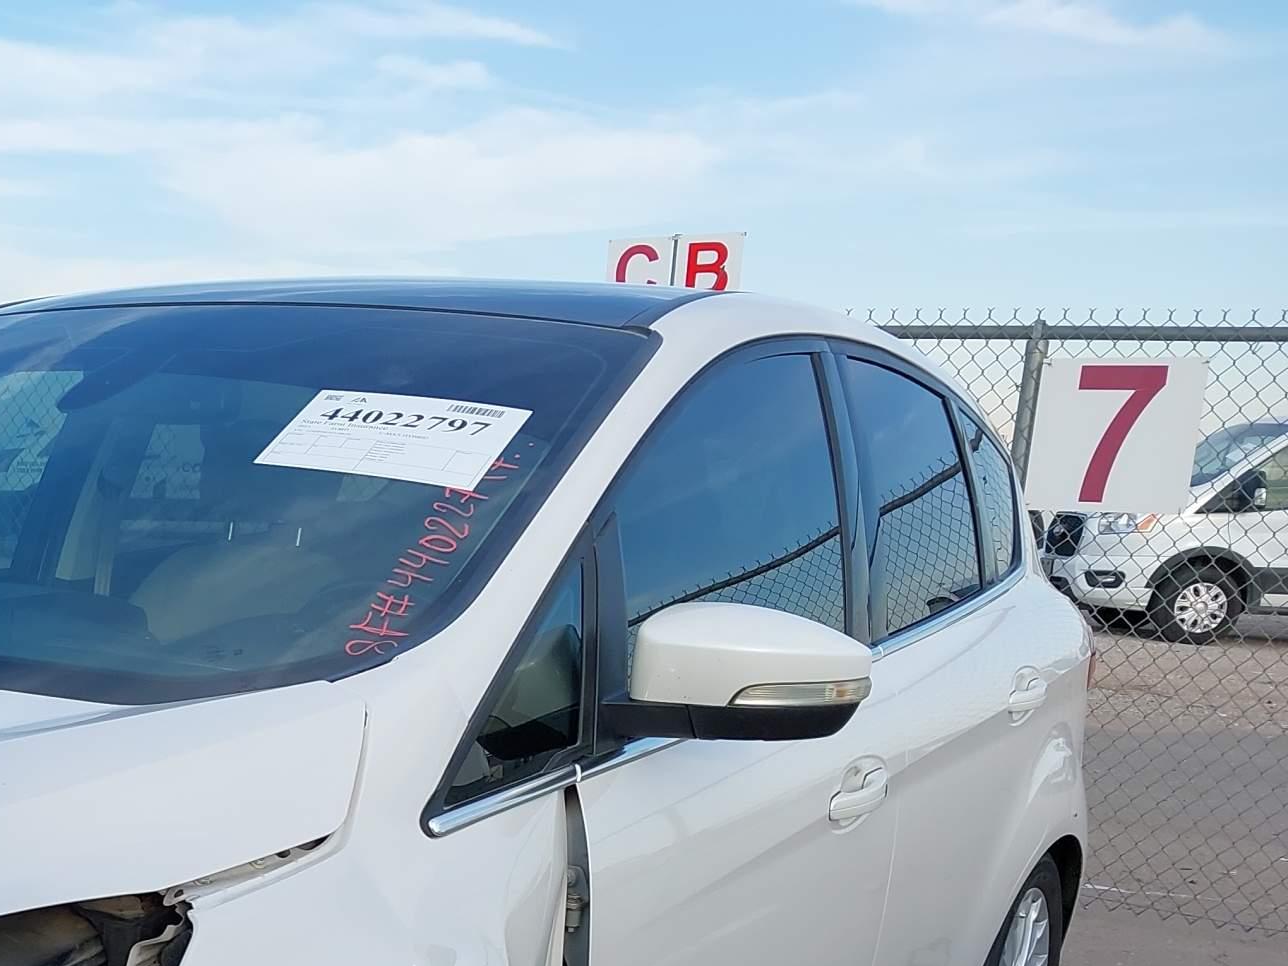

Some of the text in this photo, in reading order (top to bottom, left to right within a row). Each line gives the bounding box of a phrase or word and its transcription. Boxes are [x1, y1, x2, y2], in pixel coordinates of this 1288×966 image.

[615, 243, 659, 285] C
[685, 241, 729, 291] B
[320, 406, 492, 436] 44022797
[1078, 365, 1169, 503] 7
